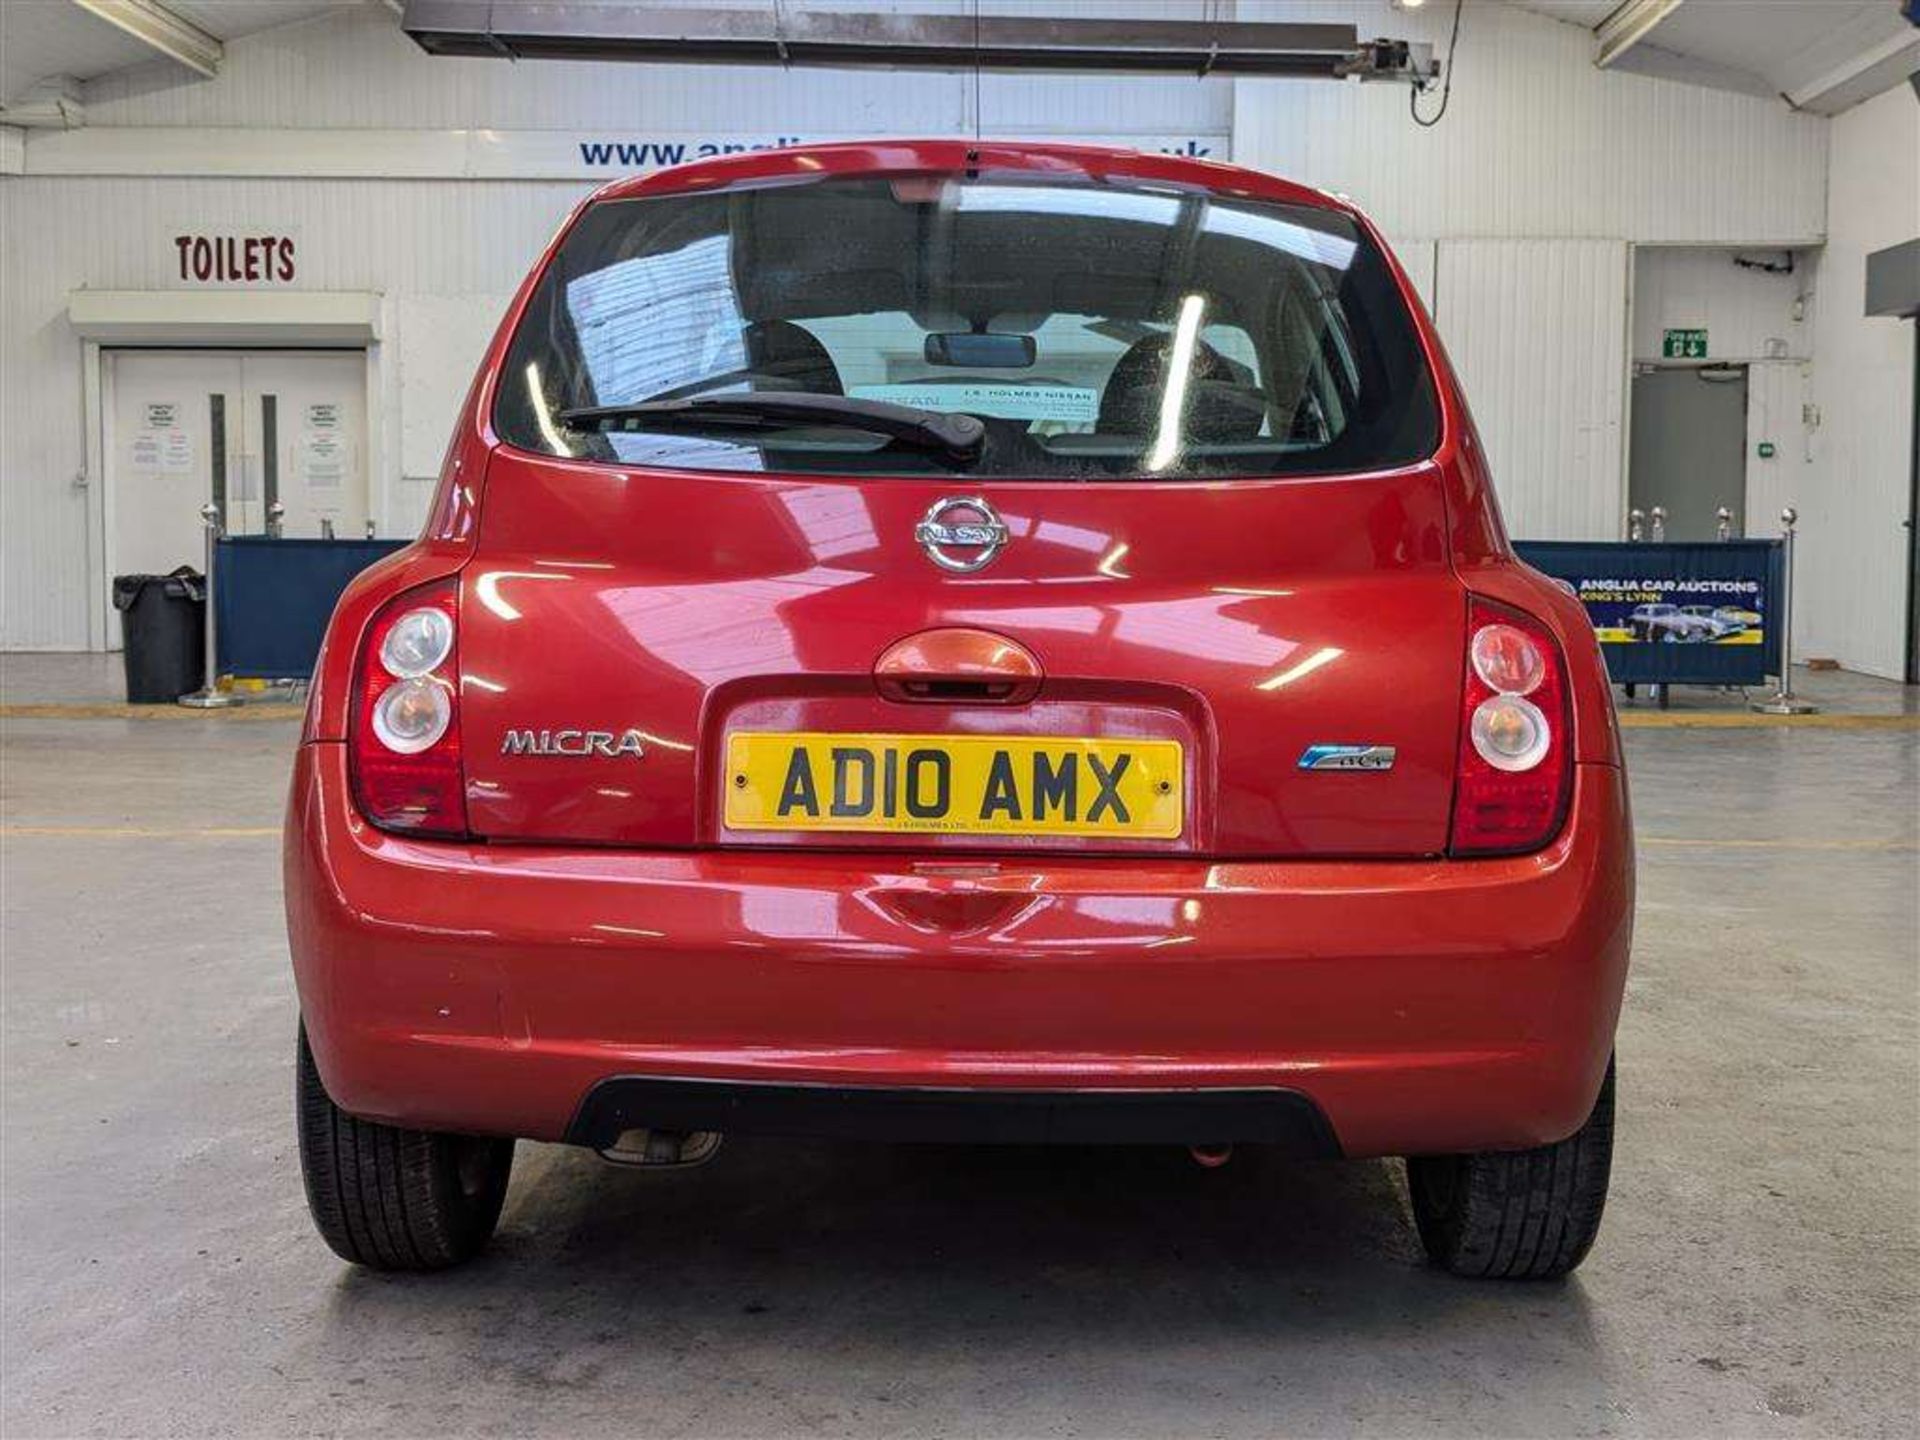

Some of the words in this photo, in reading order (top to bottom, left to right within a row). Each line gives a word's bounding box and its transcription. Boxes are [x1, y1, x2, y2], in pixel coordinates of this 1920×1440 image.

[175, 236, 295, 281] TOILETS
[1044, 391, 1091, 401] NISSAN
[1579, 579, 1639, 592] ANGLIA
[1641, 580, 1674, 592] CAR
[1676, 580, 1758, 594] AUCTIONS
[1579, 591, 1624, 602] KING'S
[1626, 592, 1662, 602] LYNN
[501, 730, 644, 756] MICRA
[777, 747, 951, 818] AD10
[979, 750, 1132, 824] AMX
